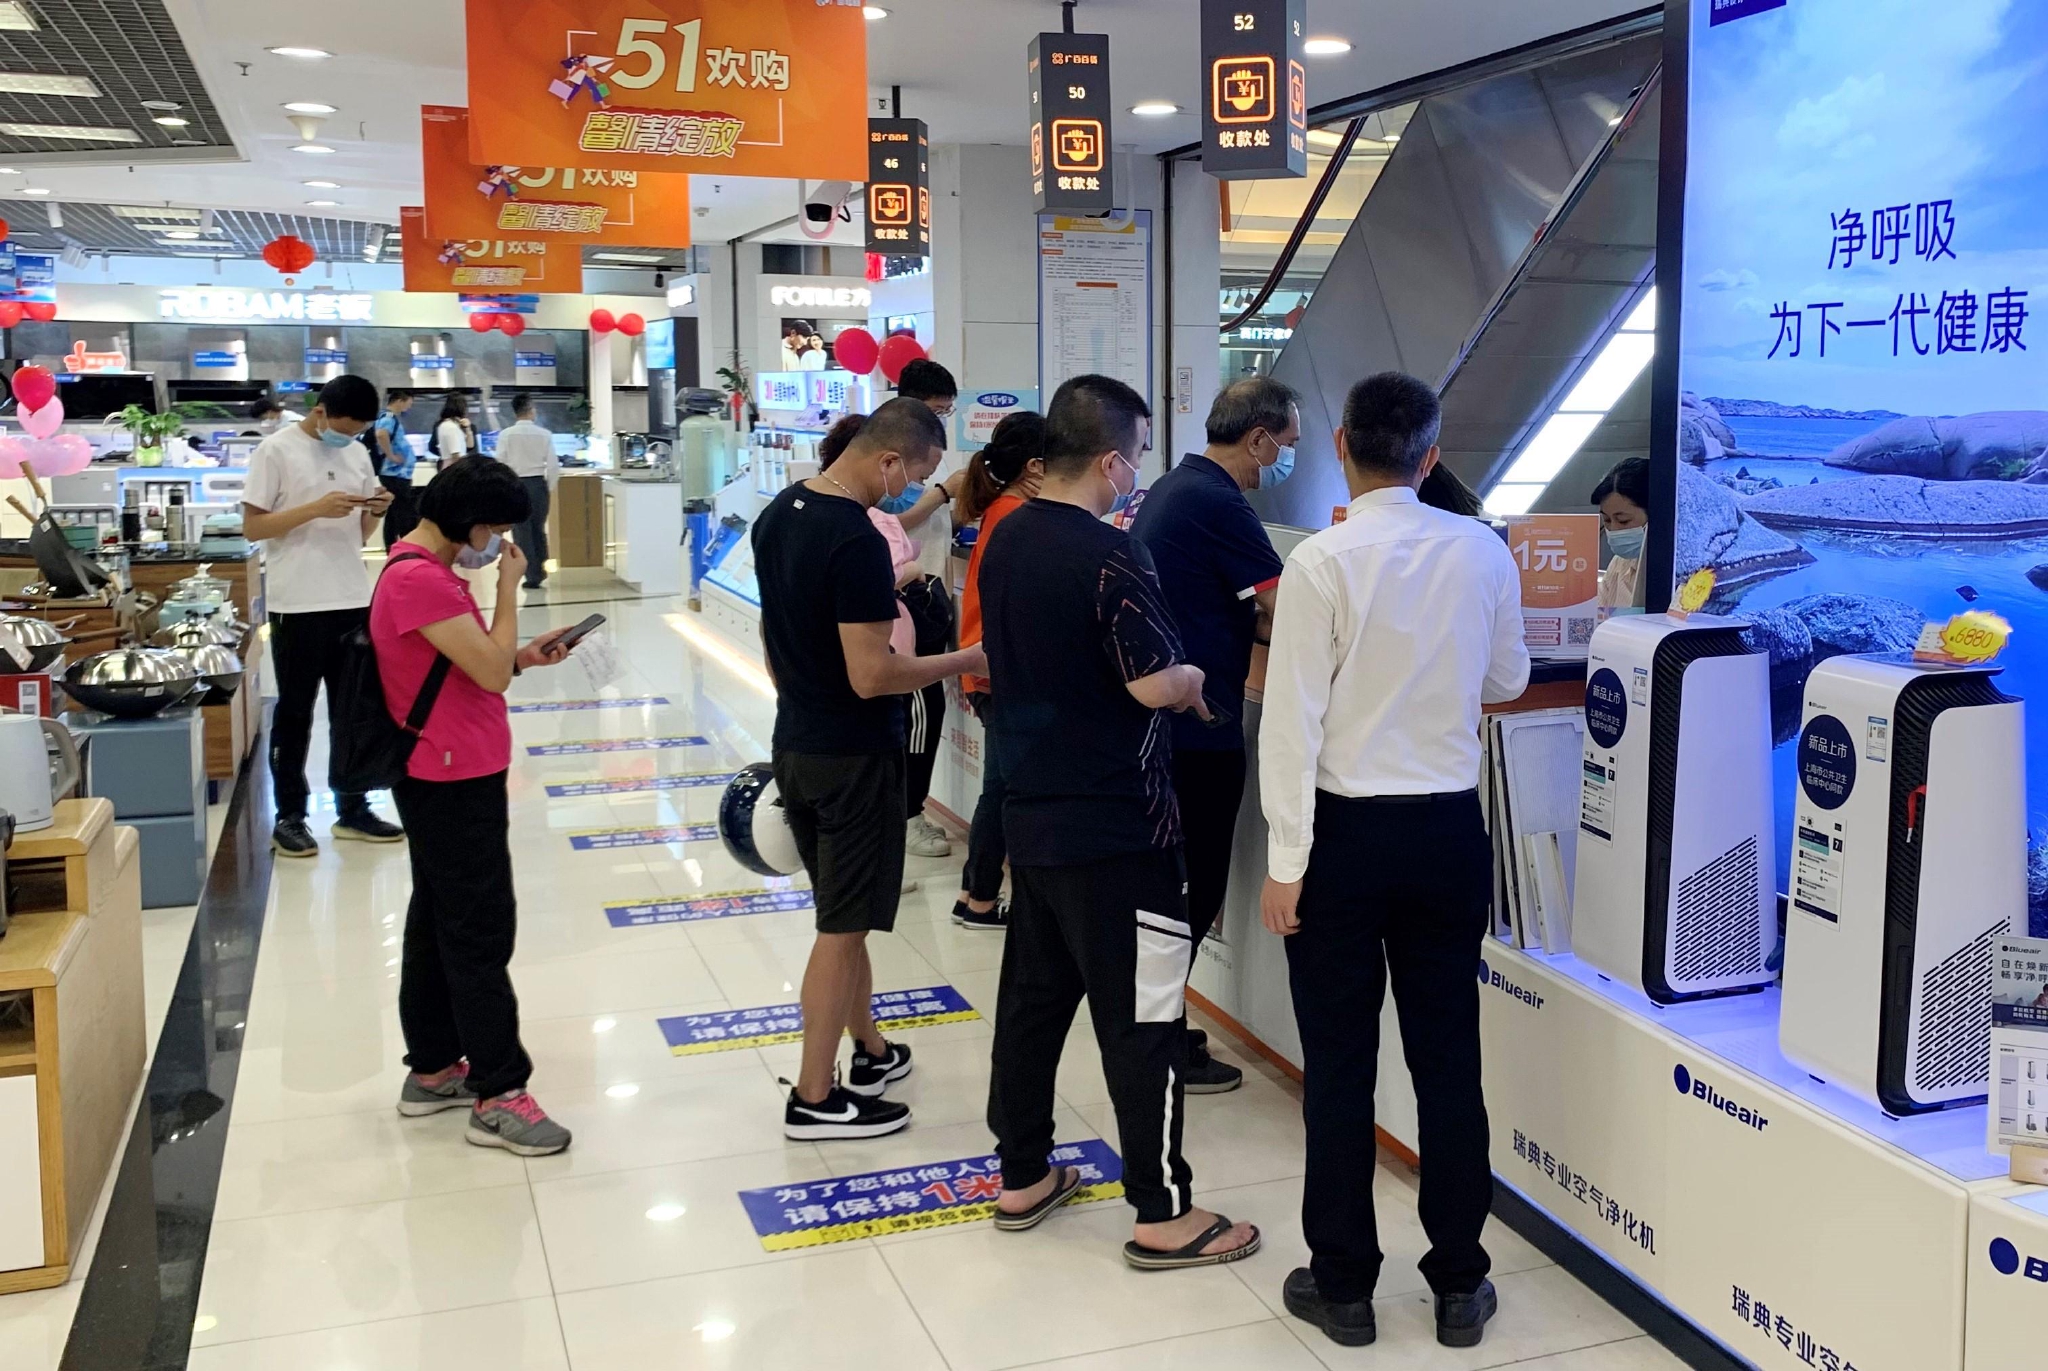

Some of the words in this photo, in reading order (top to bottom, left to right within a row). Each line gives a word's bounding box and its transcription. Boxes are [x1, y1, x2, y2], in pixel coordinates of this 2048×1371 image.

[1234, 15, 1254, 31] 52
[609, 17, 791, 93] 51欢购
[1069, 86, 1085, 100] 50
[580, 112, 744, 158] 馨情绽放
[1219, 129, 1270, 148] 收款处
[883, 158, 899, 169] 46
[1058, 176, 1100, 190] 收款处
[1828, 199, 1957, 270] 净呼吸
[1766, 286, 2029, 360] 为下一代健康
[1513, 540, 1568, 572] 1元
[1592, 684, 1621, 705] 新品上市
[1808, 734, 1848, 759] 新品上市
[1804, 762, 1848, 785] 上海市公共卫生
[1805, 774, 1844, 796] 临床中心同款
[2009, 946, 2042, 955] Blueair
[1491, 969, 1544, 1010] Blueair
[1692, 1078, 1768, 1133] Blueair
[775, 1146, 1085, 1203] 为了您和他人的康
[784, 1164, 1104, 1226] 请保持1米离
[1513, 1128, 1656, 1255] 瑞典专业空气净化机
[1732, 1284, 1859, 1371] 瑞典专业空
